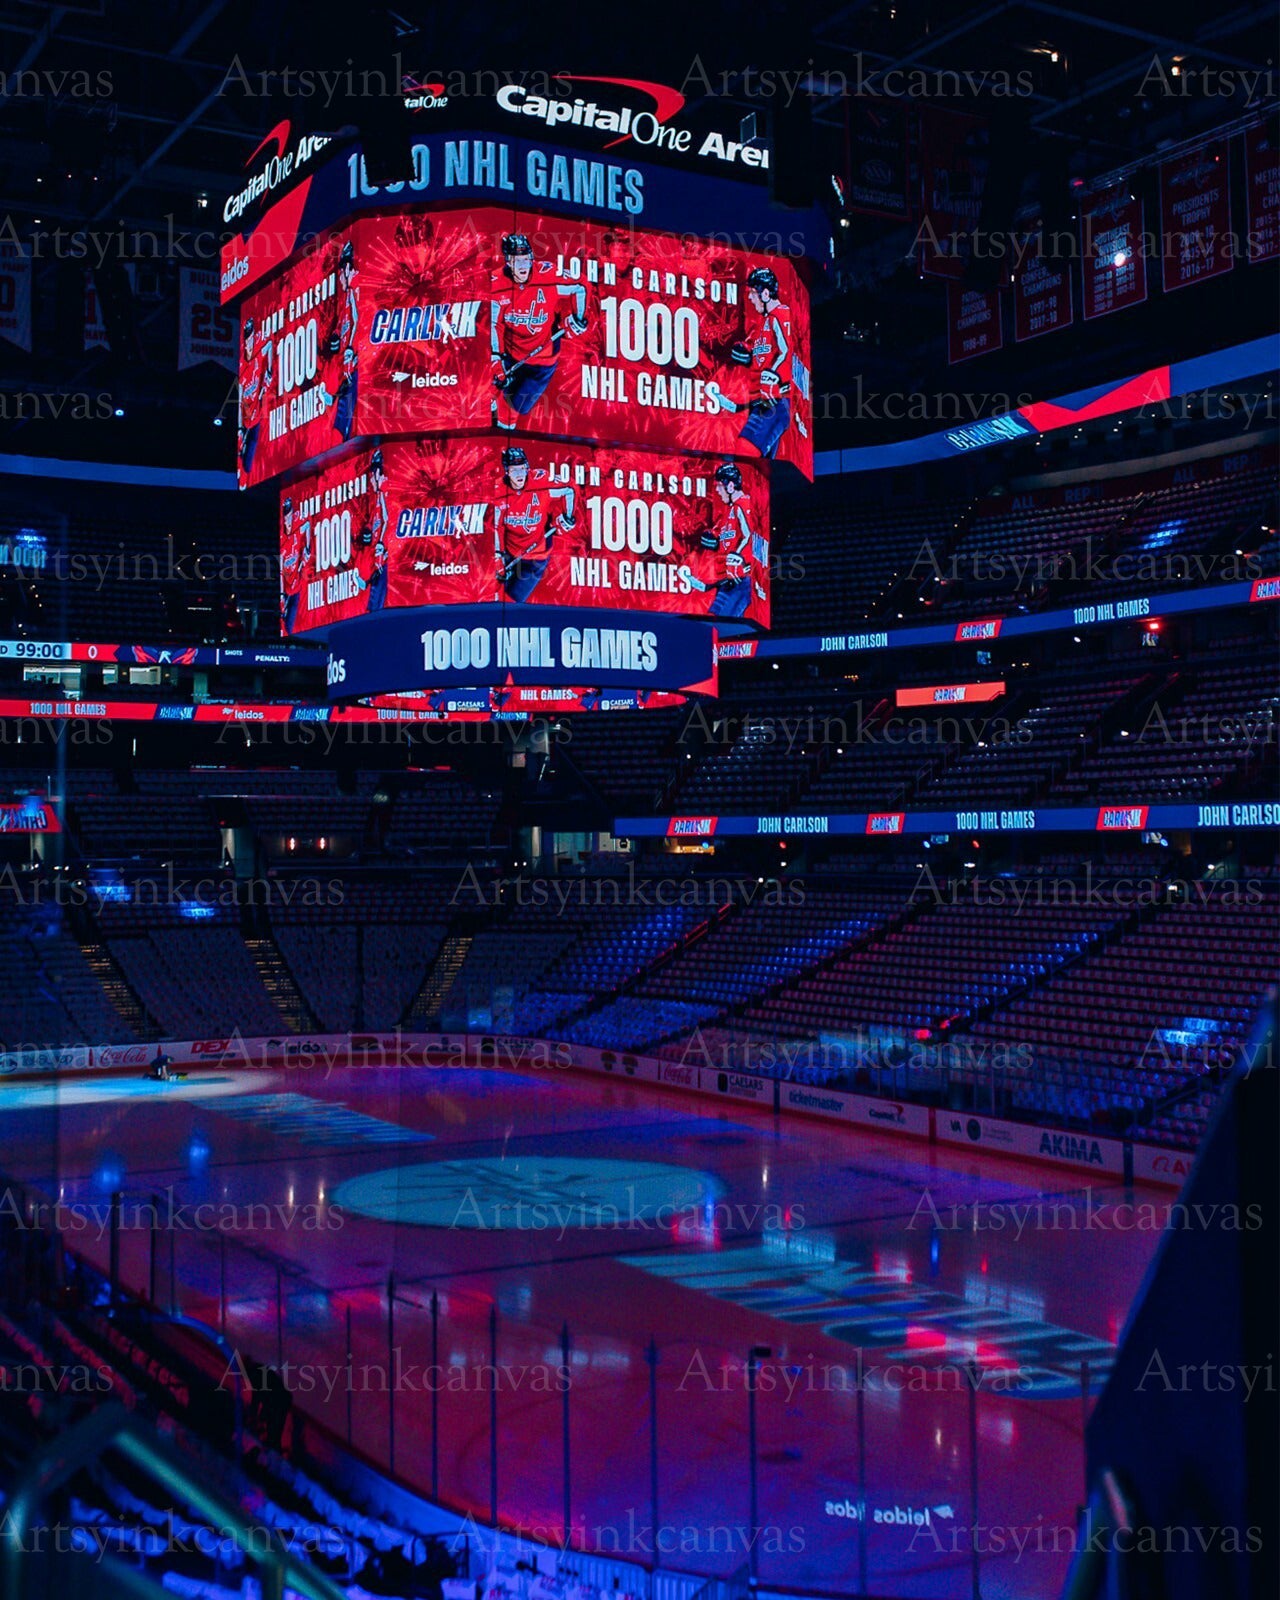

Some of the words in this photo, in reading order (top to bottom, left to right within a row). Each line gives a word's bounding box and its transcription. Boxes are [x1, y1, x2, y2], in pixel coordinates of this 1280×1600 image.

[444, 139, 515, 192] NHL
[526, 149, 645, 215] GAMES
[556, 254, 617, 286] JOHN
[632, 267, 739, 306] CARLSON
[289, 272, 336, 323] CARLSON
[191, 303, 233, 342] 25
[600, 295, 700, 369] 1000
[276, 318, 318, 397] 1000
[411, 371, 458, 388] leidos
[581, 363, 629, 404] NHL
[636, 372, 722, 415] GAMES
[268, 400, 288, 442] NHL
[290, 381, 327, 431] GAMES
[324, 473, 368, 510] CARLSON
[548, 461, 600, 486] JOHN
[613, 469, 707, 498] CARLSON
[586, 495, 673, 556] 1000
[313, 509, 352, 573] 1000
[430, 561, 469, 577] leidos
[570, 556, 612, 590] NHL
[618, 560, 693, 595] GAMES
[307, 577, 326, 611] NHL
[327, 567, 360, 606] GAMES
[1073, 606, 1096, 625] 1000
[1097, 603, 1115, 622] NHL
[1117, 597, 1150, 618] GAMES
[16, 642, 63, 659] 99:00
[87, 645, 98, 659] 0
[421, 627, 491, 672] 1000
[497, 626, 555, 669] NHL
[561, 627, 658, 673] GAMES
[820, 636, 846, 653] JOHN
[847, 632, 889, 650] CARLSON
[254, 654, 290, 663] PENALTY:
[457, 700, 485, 709] CAESARS
[520, 689, 539, 701] NHL
[540, 688, 574, 701] GAMES
[30, 702, 53, 715] 1000
[74, 703, 107, 716] GAMES
[234, 709, 265, 720] leidos
[757, 816, 782, 834] JOHN
[783, 816, 829, 834] CARLSON
[956, 812, 979, 831] 1000
[980, 811, 999, 830] NHL
[1000, 810, 1036, 830] GAMES
[1197, 805, 1230, 827] JOHN
[100, 1046, 149, 1066] Coca-Cola
[729, 1074, 764, 1092] CAESARS
[789, 1091, 844, 1113] ticketmaster
[1038, 1132, 1104, 1165] AKIMA
